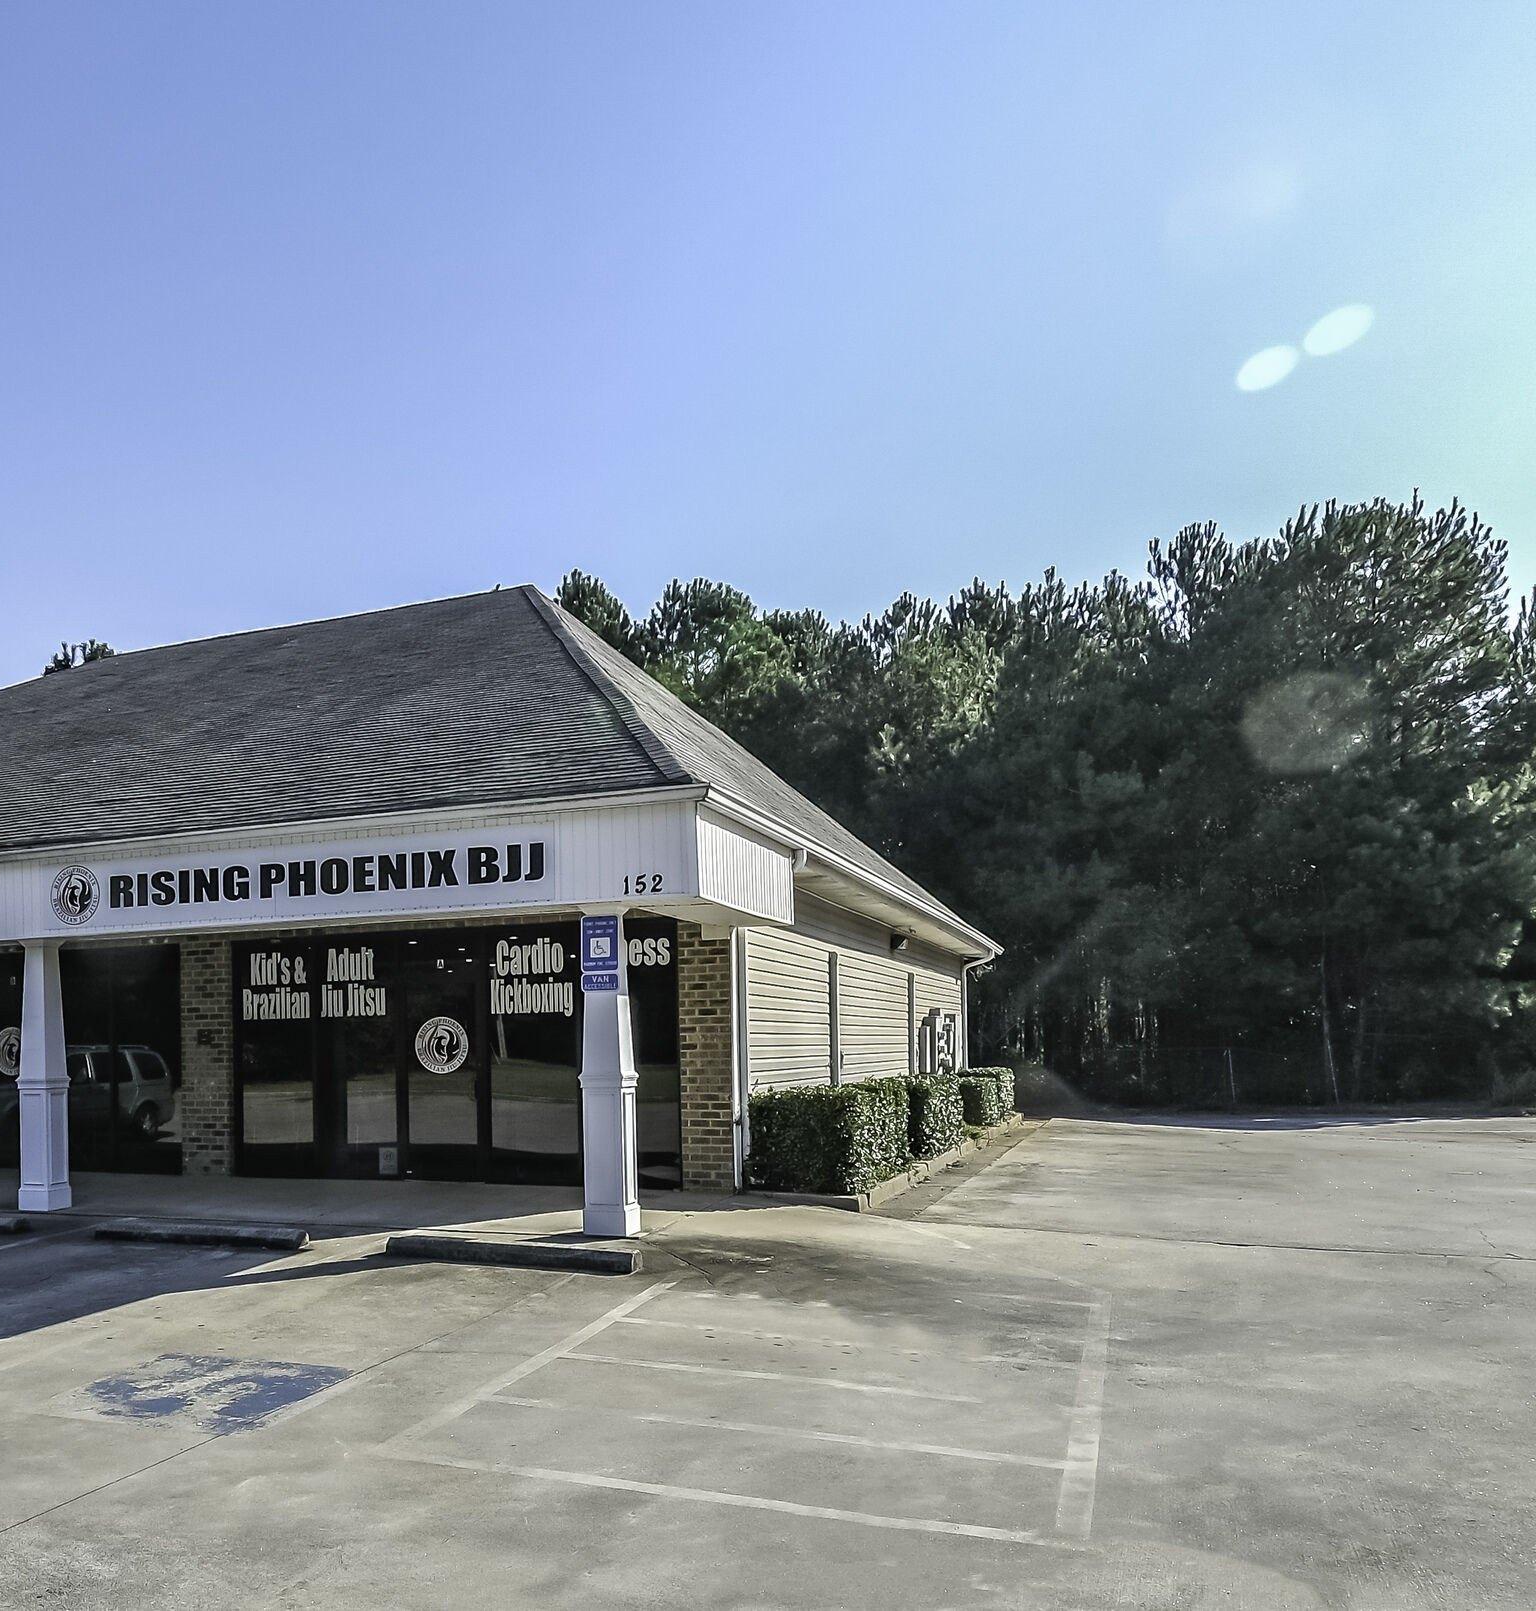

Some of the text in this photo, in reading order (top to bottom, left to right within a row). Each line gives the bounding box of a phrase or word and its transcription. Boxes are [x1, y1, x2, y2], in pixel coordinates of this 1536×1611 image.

[109, 841, 545, 908] RISING PHOENIX BJJ
[623, 873, 663, 895] 152
[250, 946, 375, 986] Kid's & Adult
[495, 937, 563, 976] Cardio
[490, 976, 574, 1017] Kickboxing
[592, 975, 609, 983] VAN
[242, 982, 386, 1021] Brazilian Jiu Jitsu
